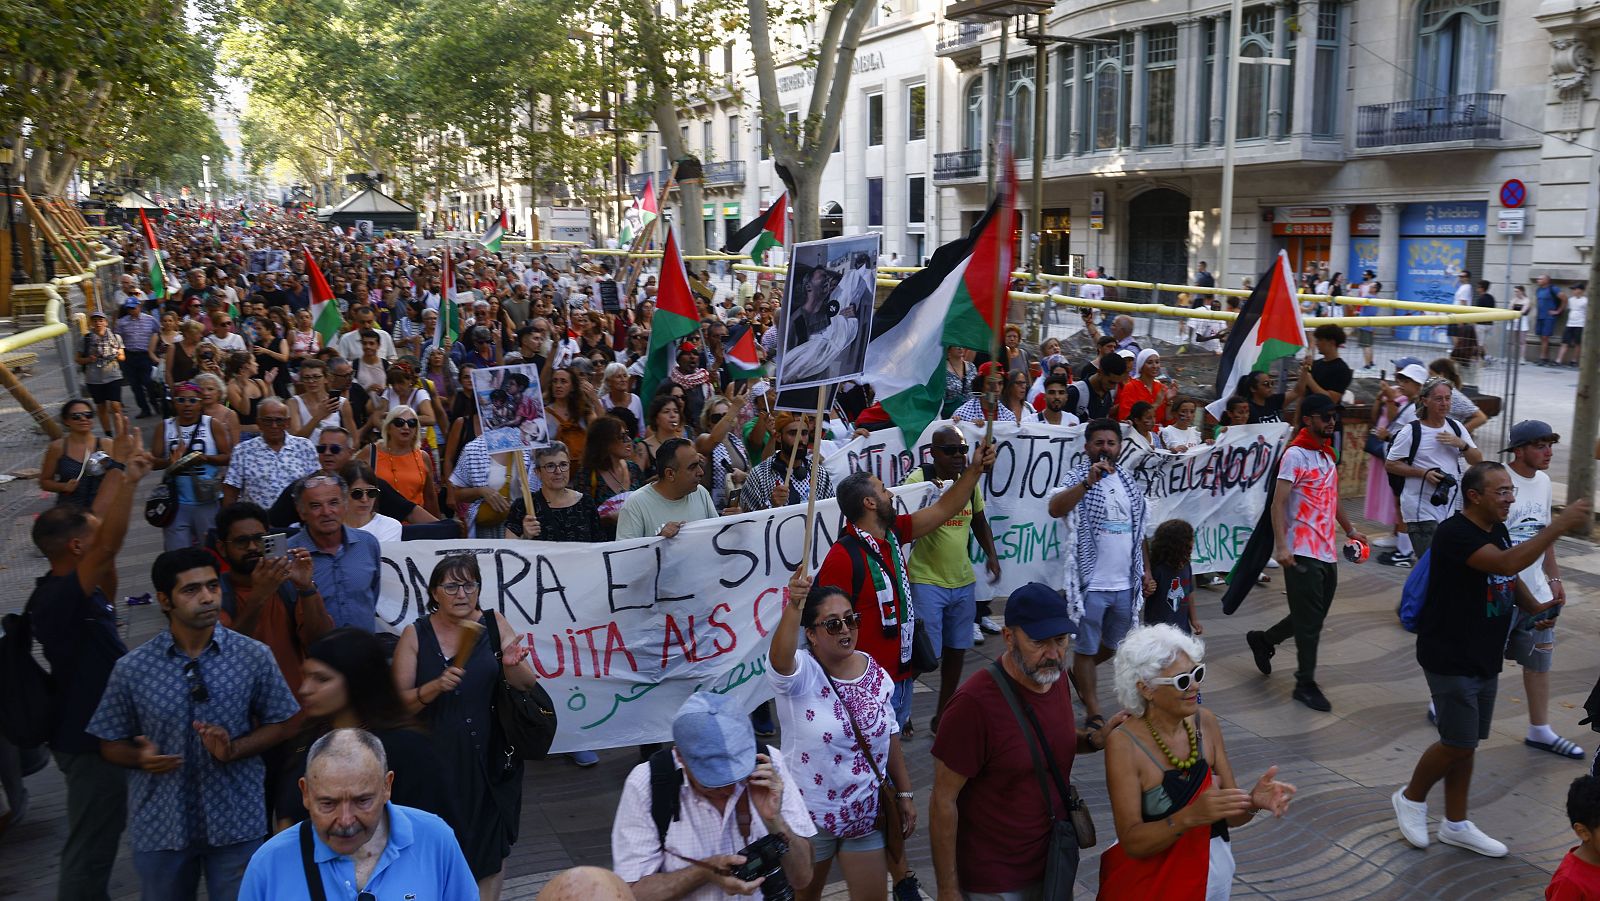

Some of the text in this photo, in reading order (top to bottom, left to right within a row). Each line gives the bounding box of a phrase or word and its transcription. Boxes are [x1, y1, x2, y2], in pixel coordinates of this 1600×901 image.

[1425, 224, 1436, 233] 93
[1467, 224, 1480, 233] 49
[376, 547, 577, 627] ONTRA
[602, 545, 696, 614] EL
[660, 602, 737, 669] ALS
